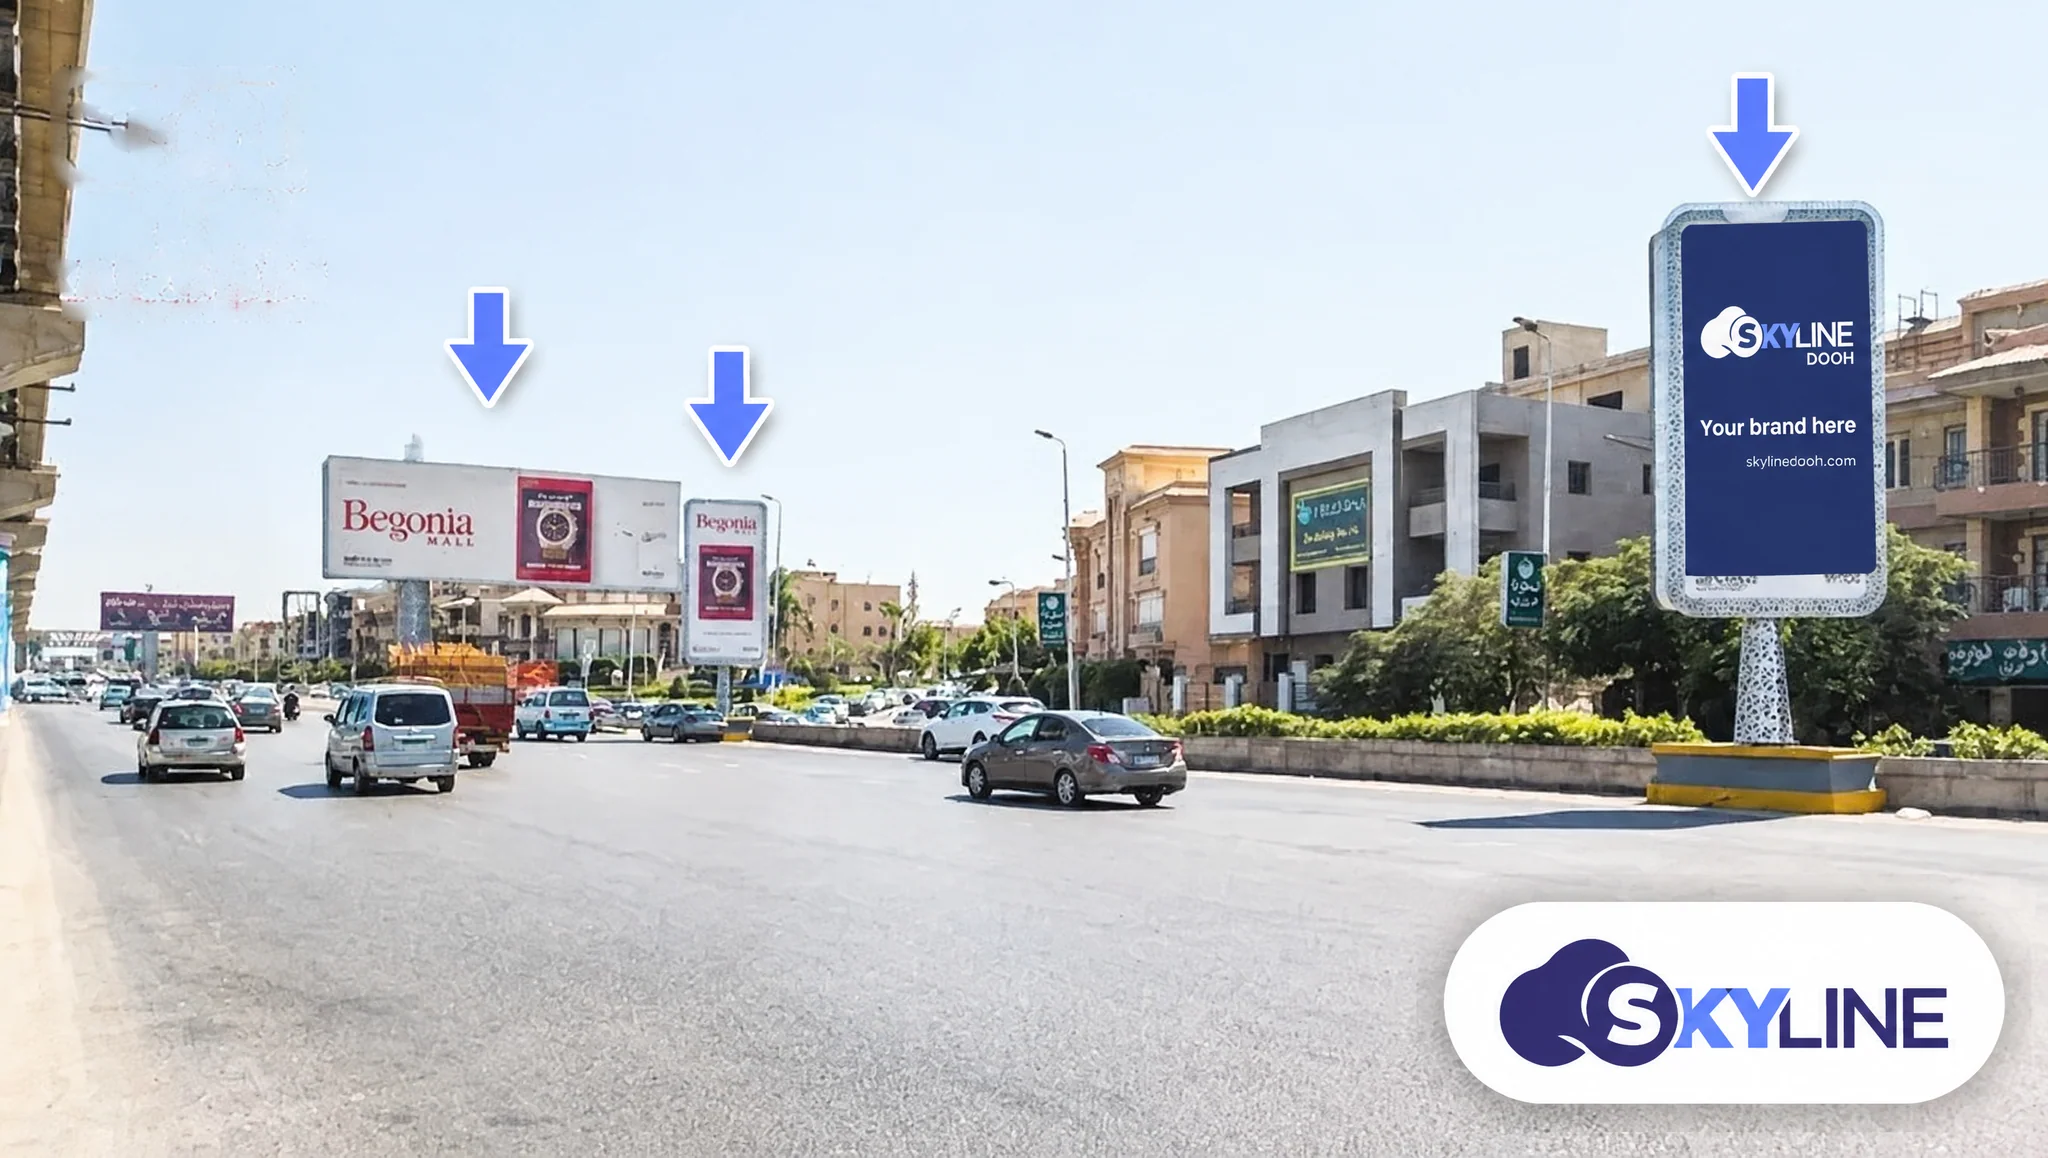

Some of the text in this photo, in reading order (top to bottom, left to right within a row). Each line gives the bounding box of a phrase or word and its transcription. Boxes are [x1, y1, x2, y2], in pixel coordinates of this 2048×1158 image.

[1738, 321, 1854, 349] SKYLINE
[1806, 351, 1854, 366] DOOH
[1700, 416, 1857, 437] Your brand here
[1746, 455, 1857, 470] skylinedooh.com
[342, 499, 474, 542] Begonia
[696, 513, 757, 533] Begonia
[427, 536, 474, 547] MALL
